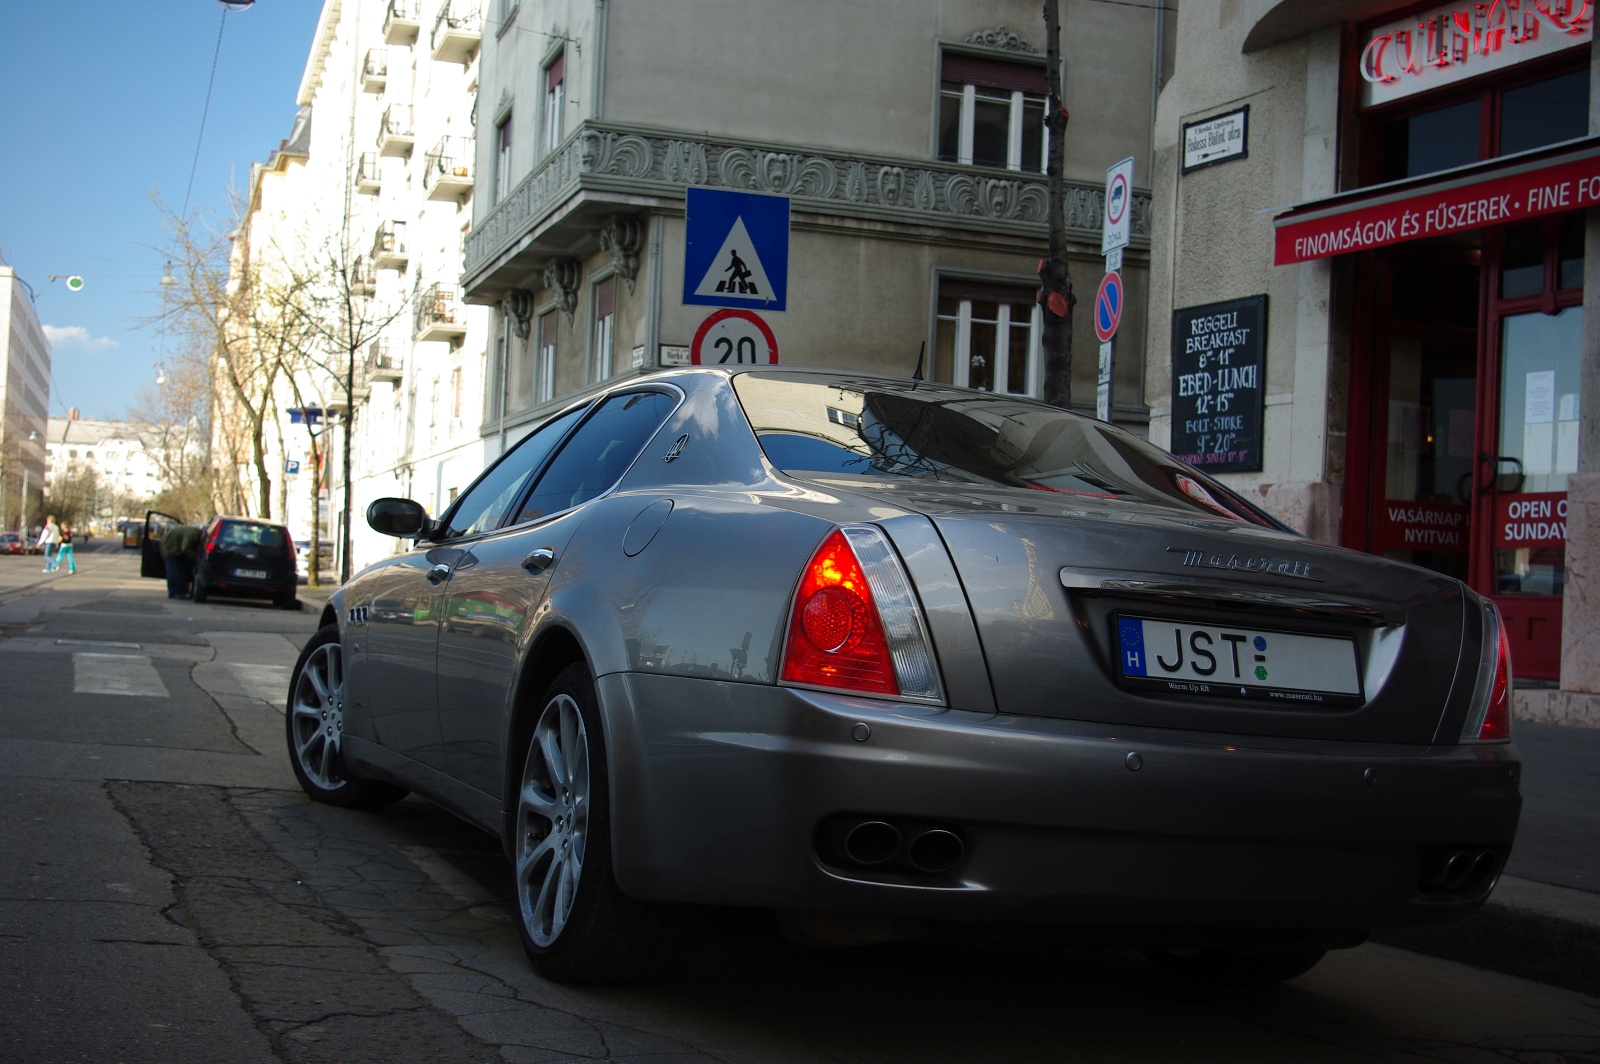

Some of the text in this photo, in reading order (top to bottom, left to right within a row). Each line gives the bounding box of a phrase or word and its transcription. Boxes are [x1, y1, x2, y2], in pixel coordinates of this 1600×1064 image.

[1360, 0, 1593, 82] CULINAR
[1295, 218, 1397, 258] FINOMSÁGOK
[1401, 211, 1419, 237] ÉS
[1425, 194, 1510, 232] FŰSZEREK
[1527, 182, 1570, 212] FINE
[1191, 312, 1237, 335] REGGELI
[714, 336, 756, 364] 20
[1186, 329, 1250, 354] BREAKFAST
[1388, 506, 1462, 526] VASÁRNAP
[1508, 500, 1551, 519] OPEN
[1405, 528, 1459, 545] NYITVA!
[1505, 521, 1567, 541] SUNDAY
[1168, 547, 1324, 582] Maserati
[1127, 651, 1139, 667] H
[1168, 682, 1210, 693] Warm Up Kft
[1270, 691, 1323, 702] www.maserati.hu
